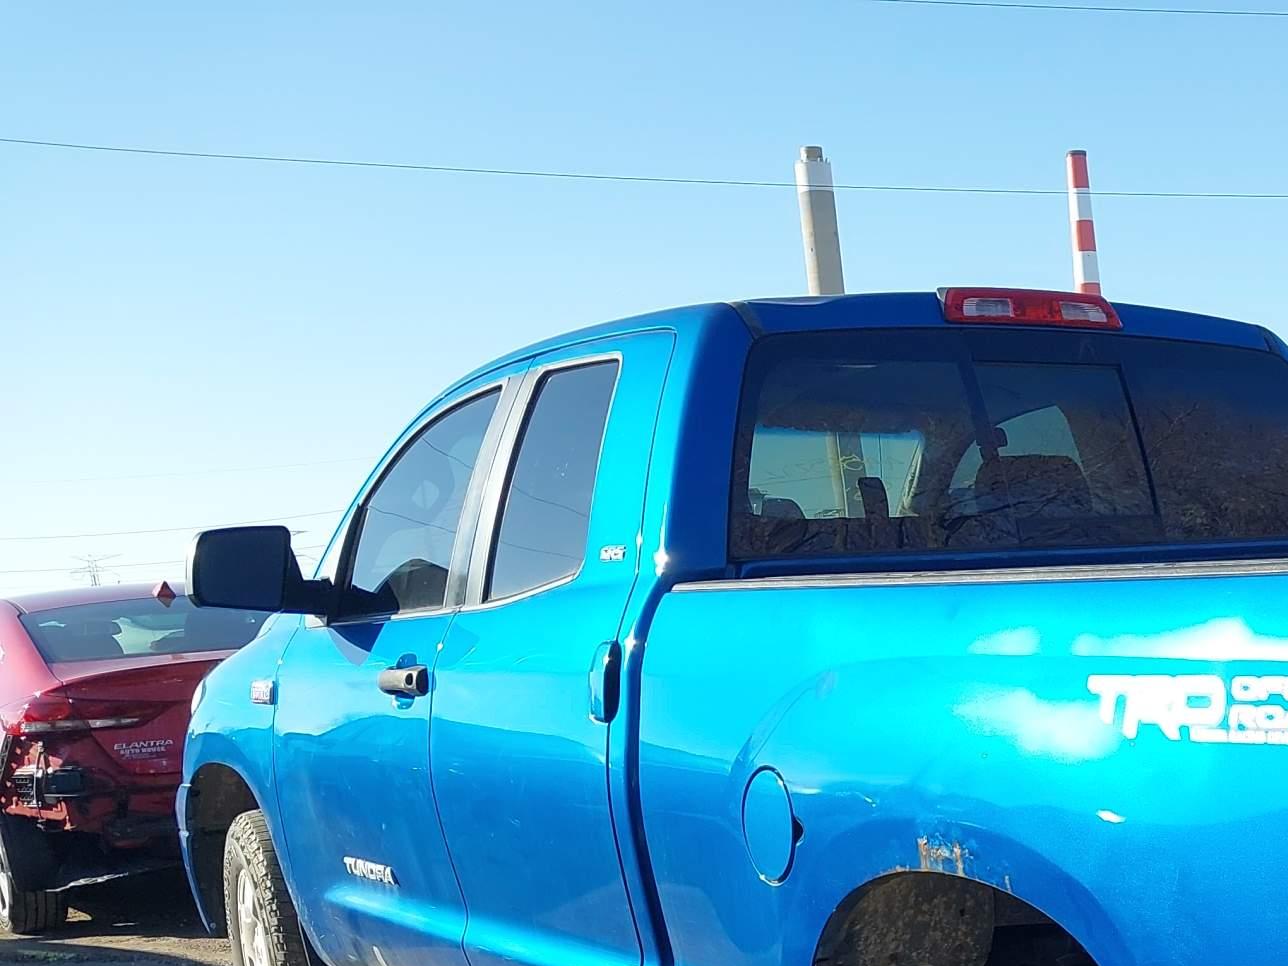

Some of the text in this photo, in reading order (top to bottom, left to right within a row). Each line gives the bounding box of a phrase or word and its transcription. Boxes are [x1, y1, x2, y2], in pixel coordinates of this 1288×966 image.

[1087, 675, 1227, 741] TRD
[113, 739, 174, 750] ELANTRA
[343, 856, 397, 886] TUNDRA
